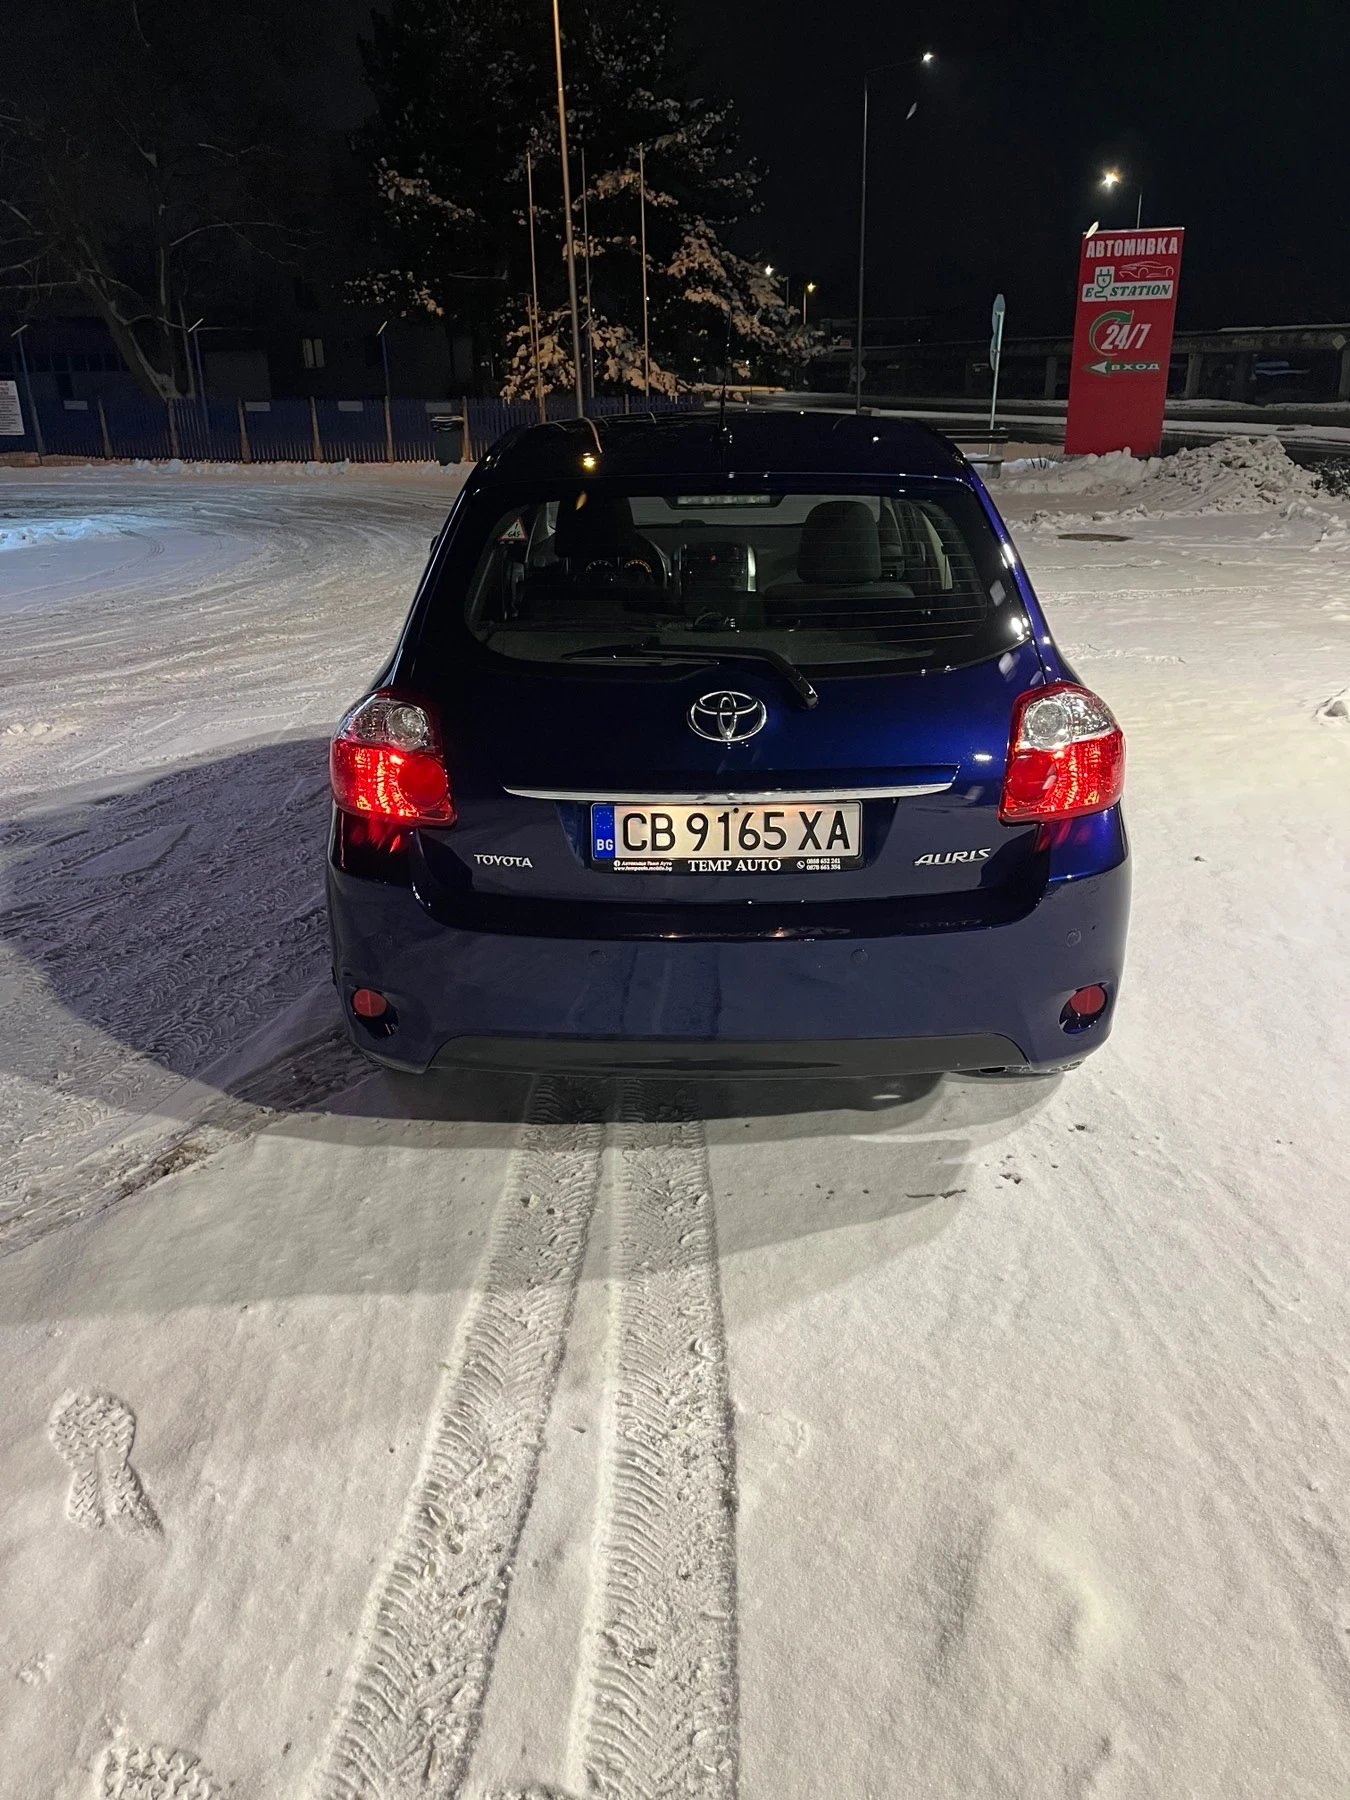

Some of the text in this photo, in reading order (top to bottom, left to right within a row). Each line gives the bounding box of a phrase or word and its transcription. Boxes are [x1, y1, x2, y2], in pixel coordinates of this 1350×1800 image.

[1086, 237, 1178, 258] АВТОМИВКА
[1085, 284, 1171, 298] E STATION
[1101, 323, 1152, 350] 24/7
[1111, 363, 1160, 371] ВХОД
[622, 810, 851, 851] CB 9165 XA
[596, 839, 614, 851] BG
[473, 854, 533, 869] TOYOTA
[914, 848, 992, 866] AURIS
[688, 859, 781, 872] TEMP AUTO
